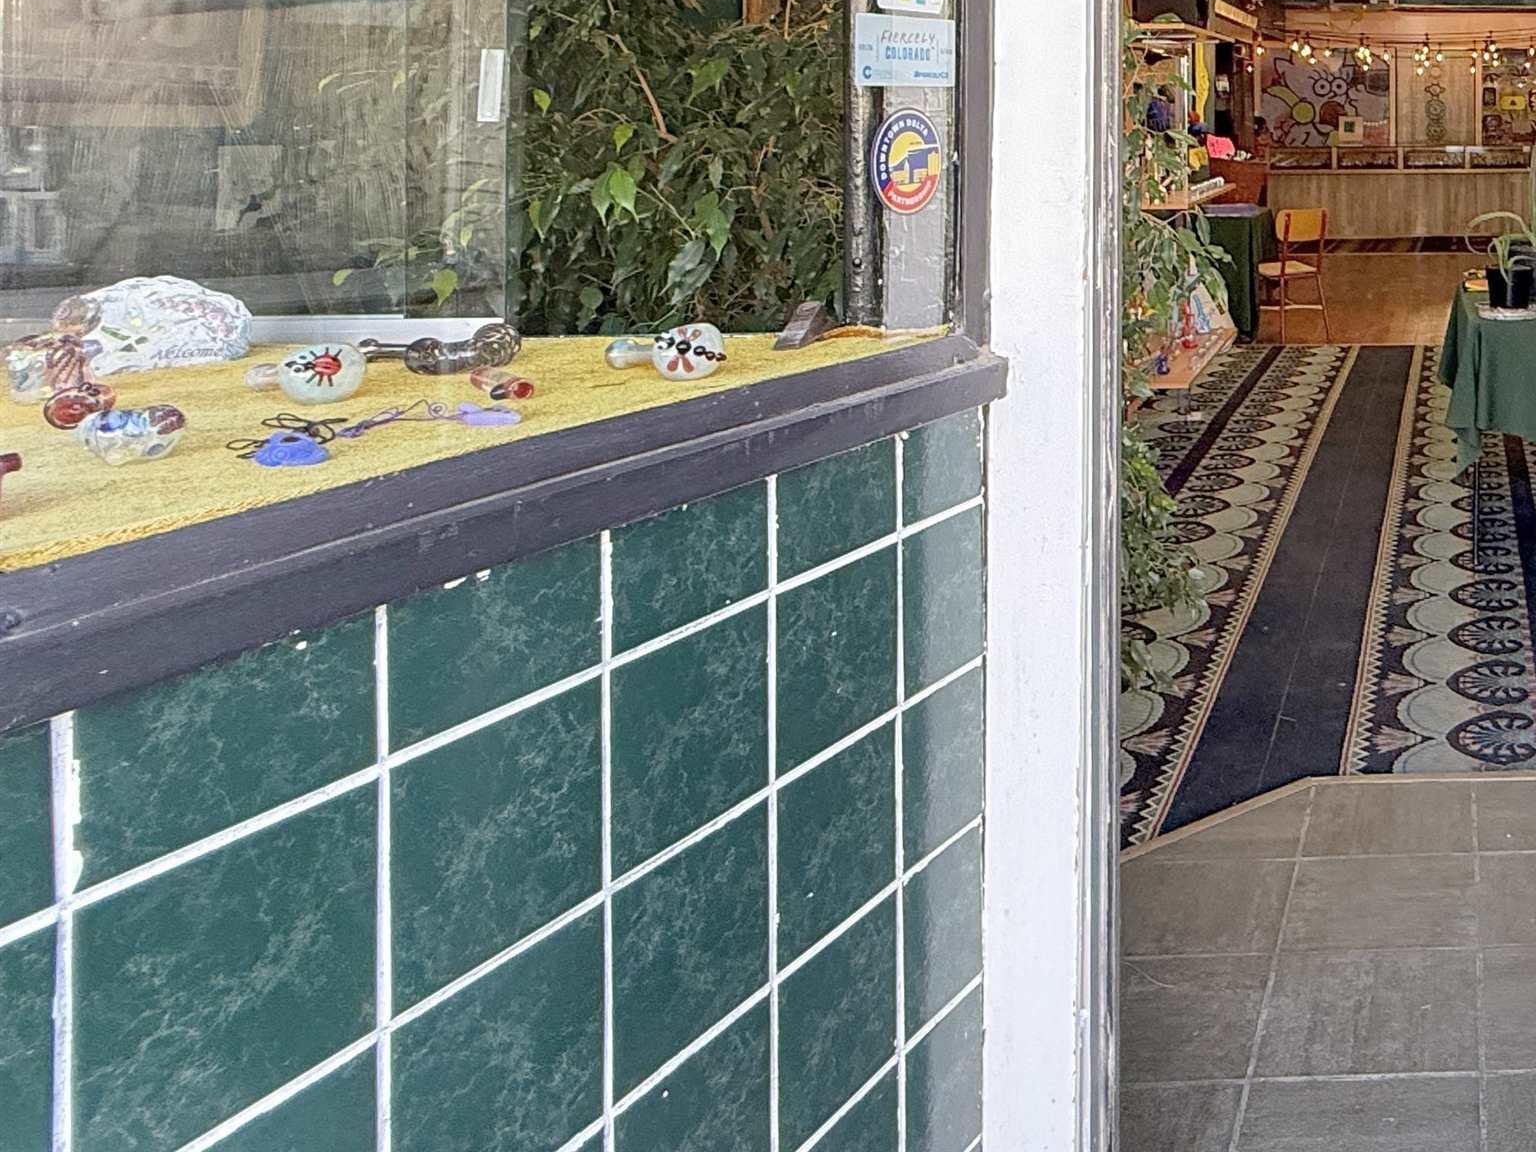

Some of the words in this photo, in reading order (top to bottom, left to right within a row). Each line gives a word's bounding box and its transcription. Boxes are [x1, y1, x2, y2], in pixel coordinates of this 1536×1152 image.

[881, 29, 936, 45] FIERCELY
[886, 46, 931, 61] COLORADO
[879, 118, 905, 181] DOWNTOWN
[906, 118, 928, 137] DELTA
